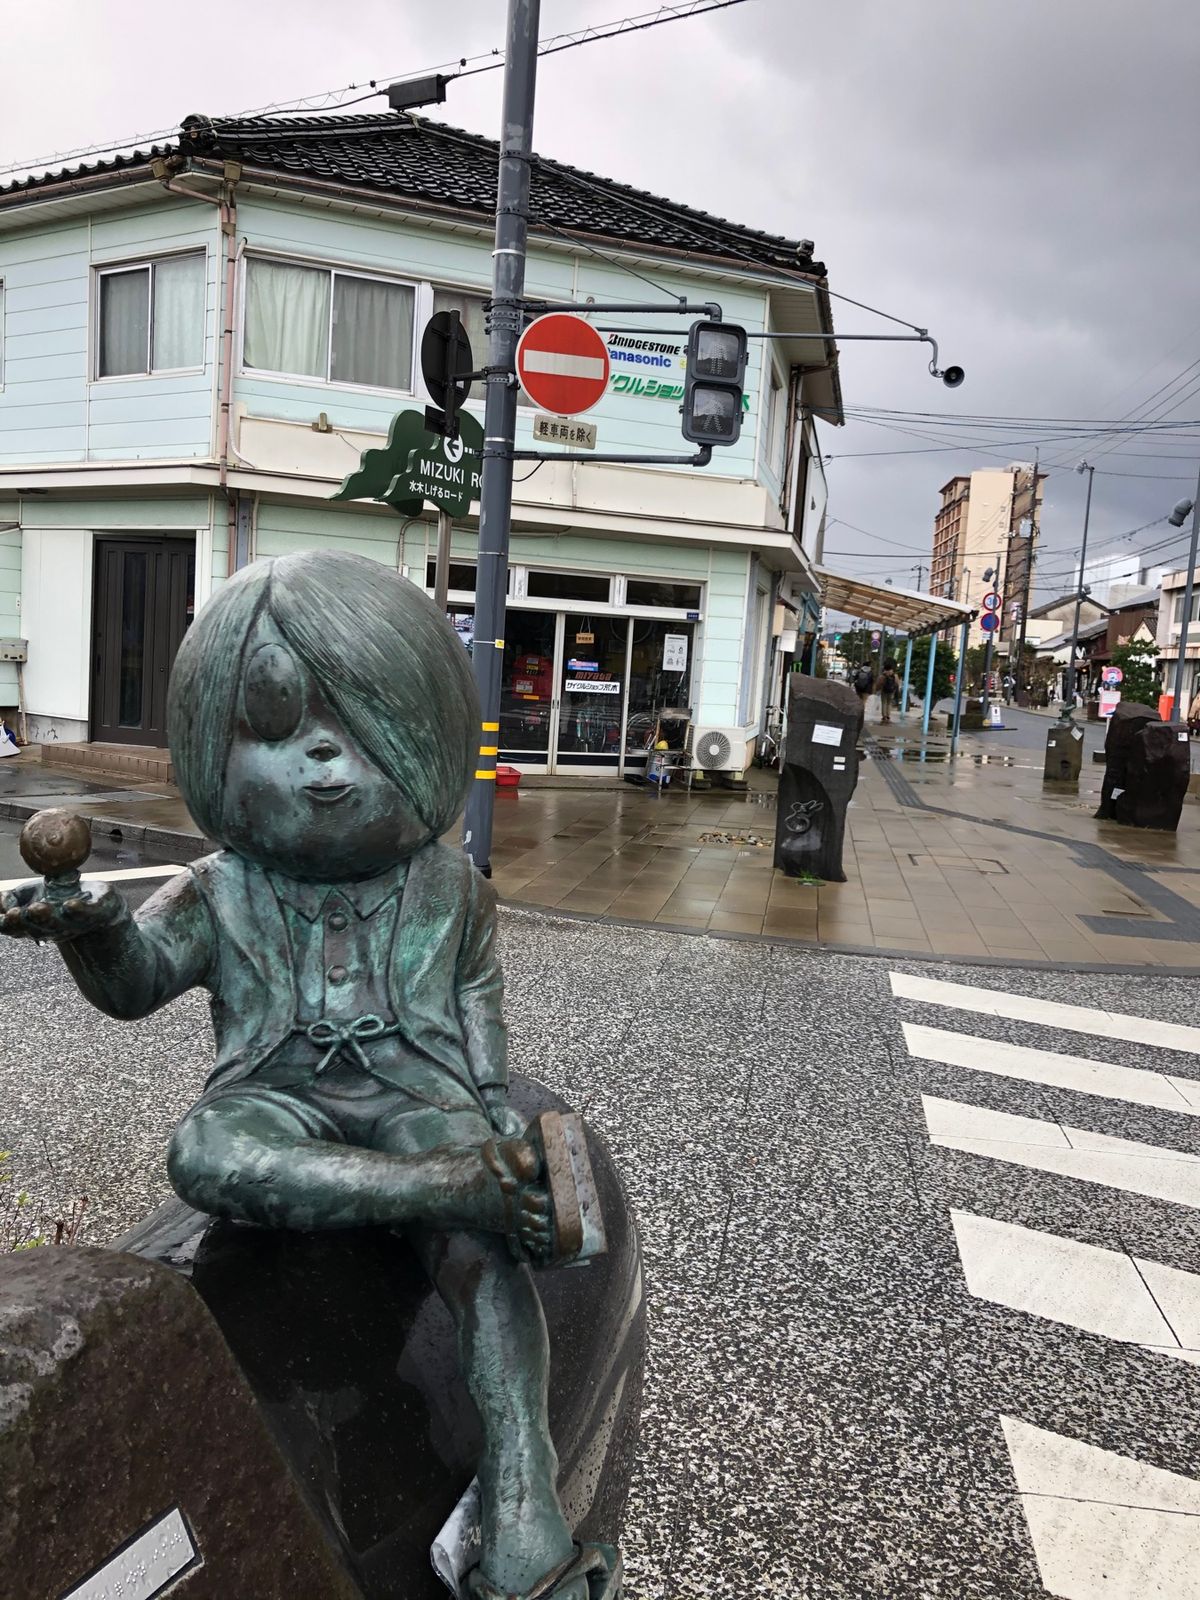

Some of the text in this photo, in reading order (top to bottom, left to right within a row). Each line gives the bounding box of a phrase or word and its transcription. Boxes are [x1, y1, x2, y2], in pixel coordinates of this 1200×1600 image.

[607, 334, 681, 355] BRIDGESTONE
[539, 421, 591, 443] 軽車両を除く
[420, 458, 465, 485] MIZUKI
[409, 480, 463, 502] 水木しげるロード
